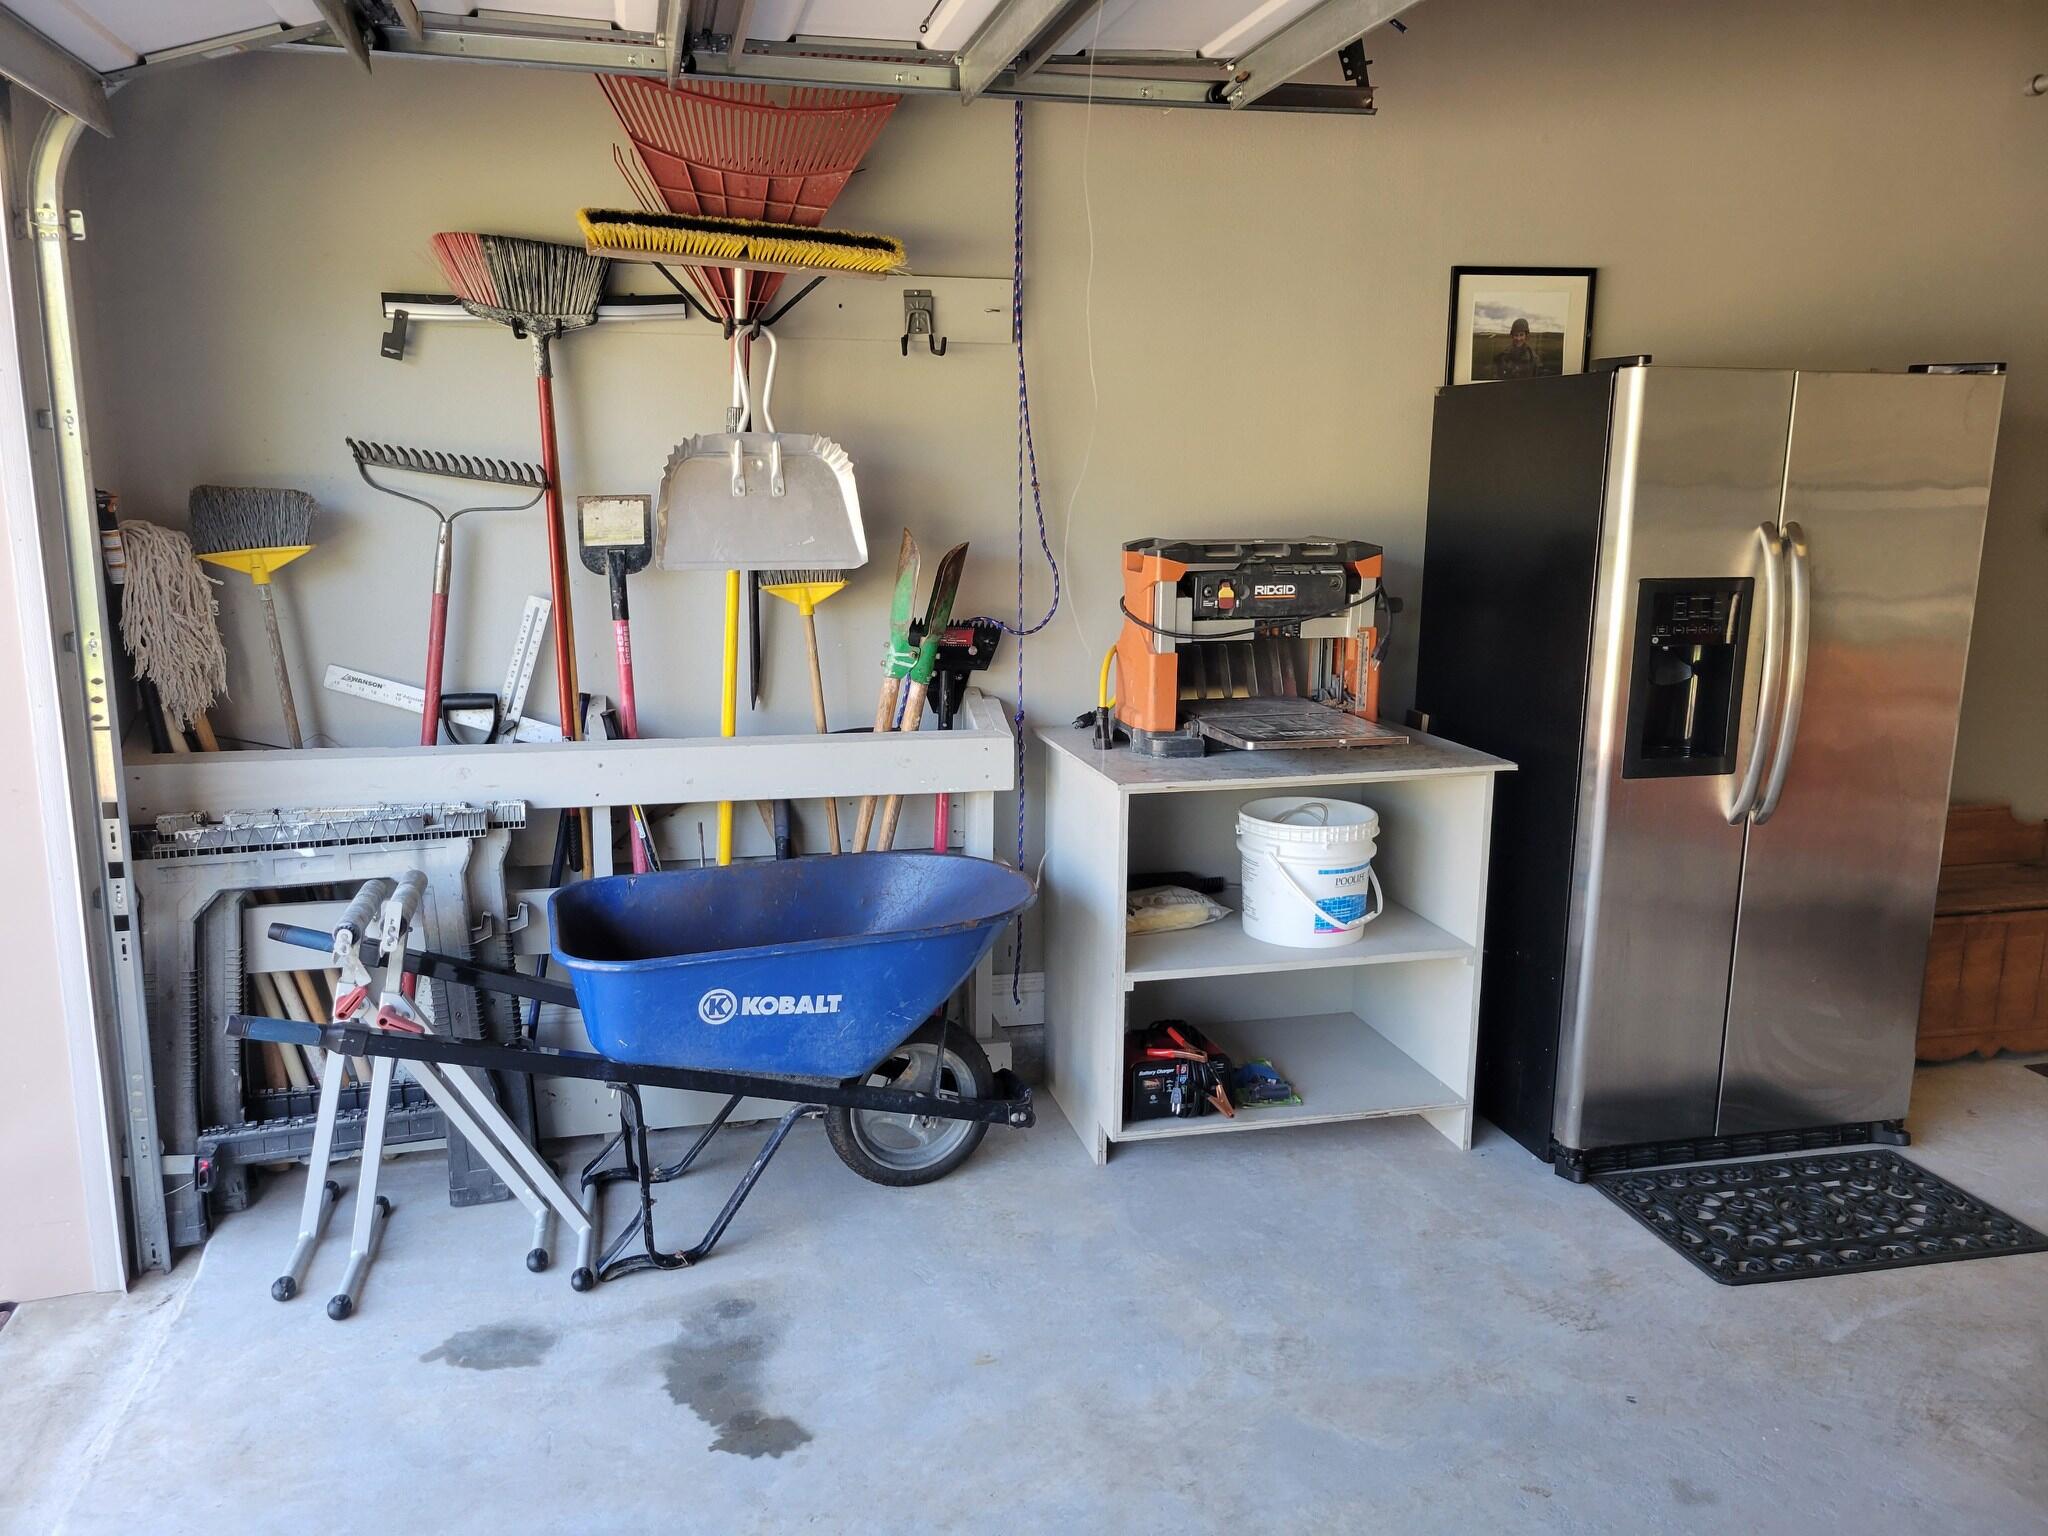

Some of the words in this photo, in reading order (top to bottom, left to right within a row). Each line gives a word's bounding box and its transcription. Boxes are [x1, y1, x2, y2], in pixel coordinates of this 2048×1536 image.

[1254, 584, 1296, 595] RIDGID
[344, 674, 384, 689] SWANSON
[741, 994, 843, 1016] KOBALT
